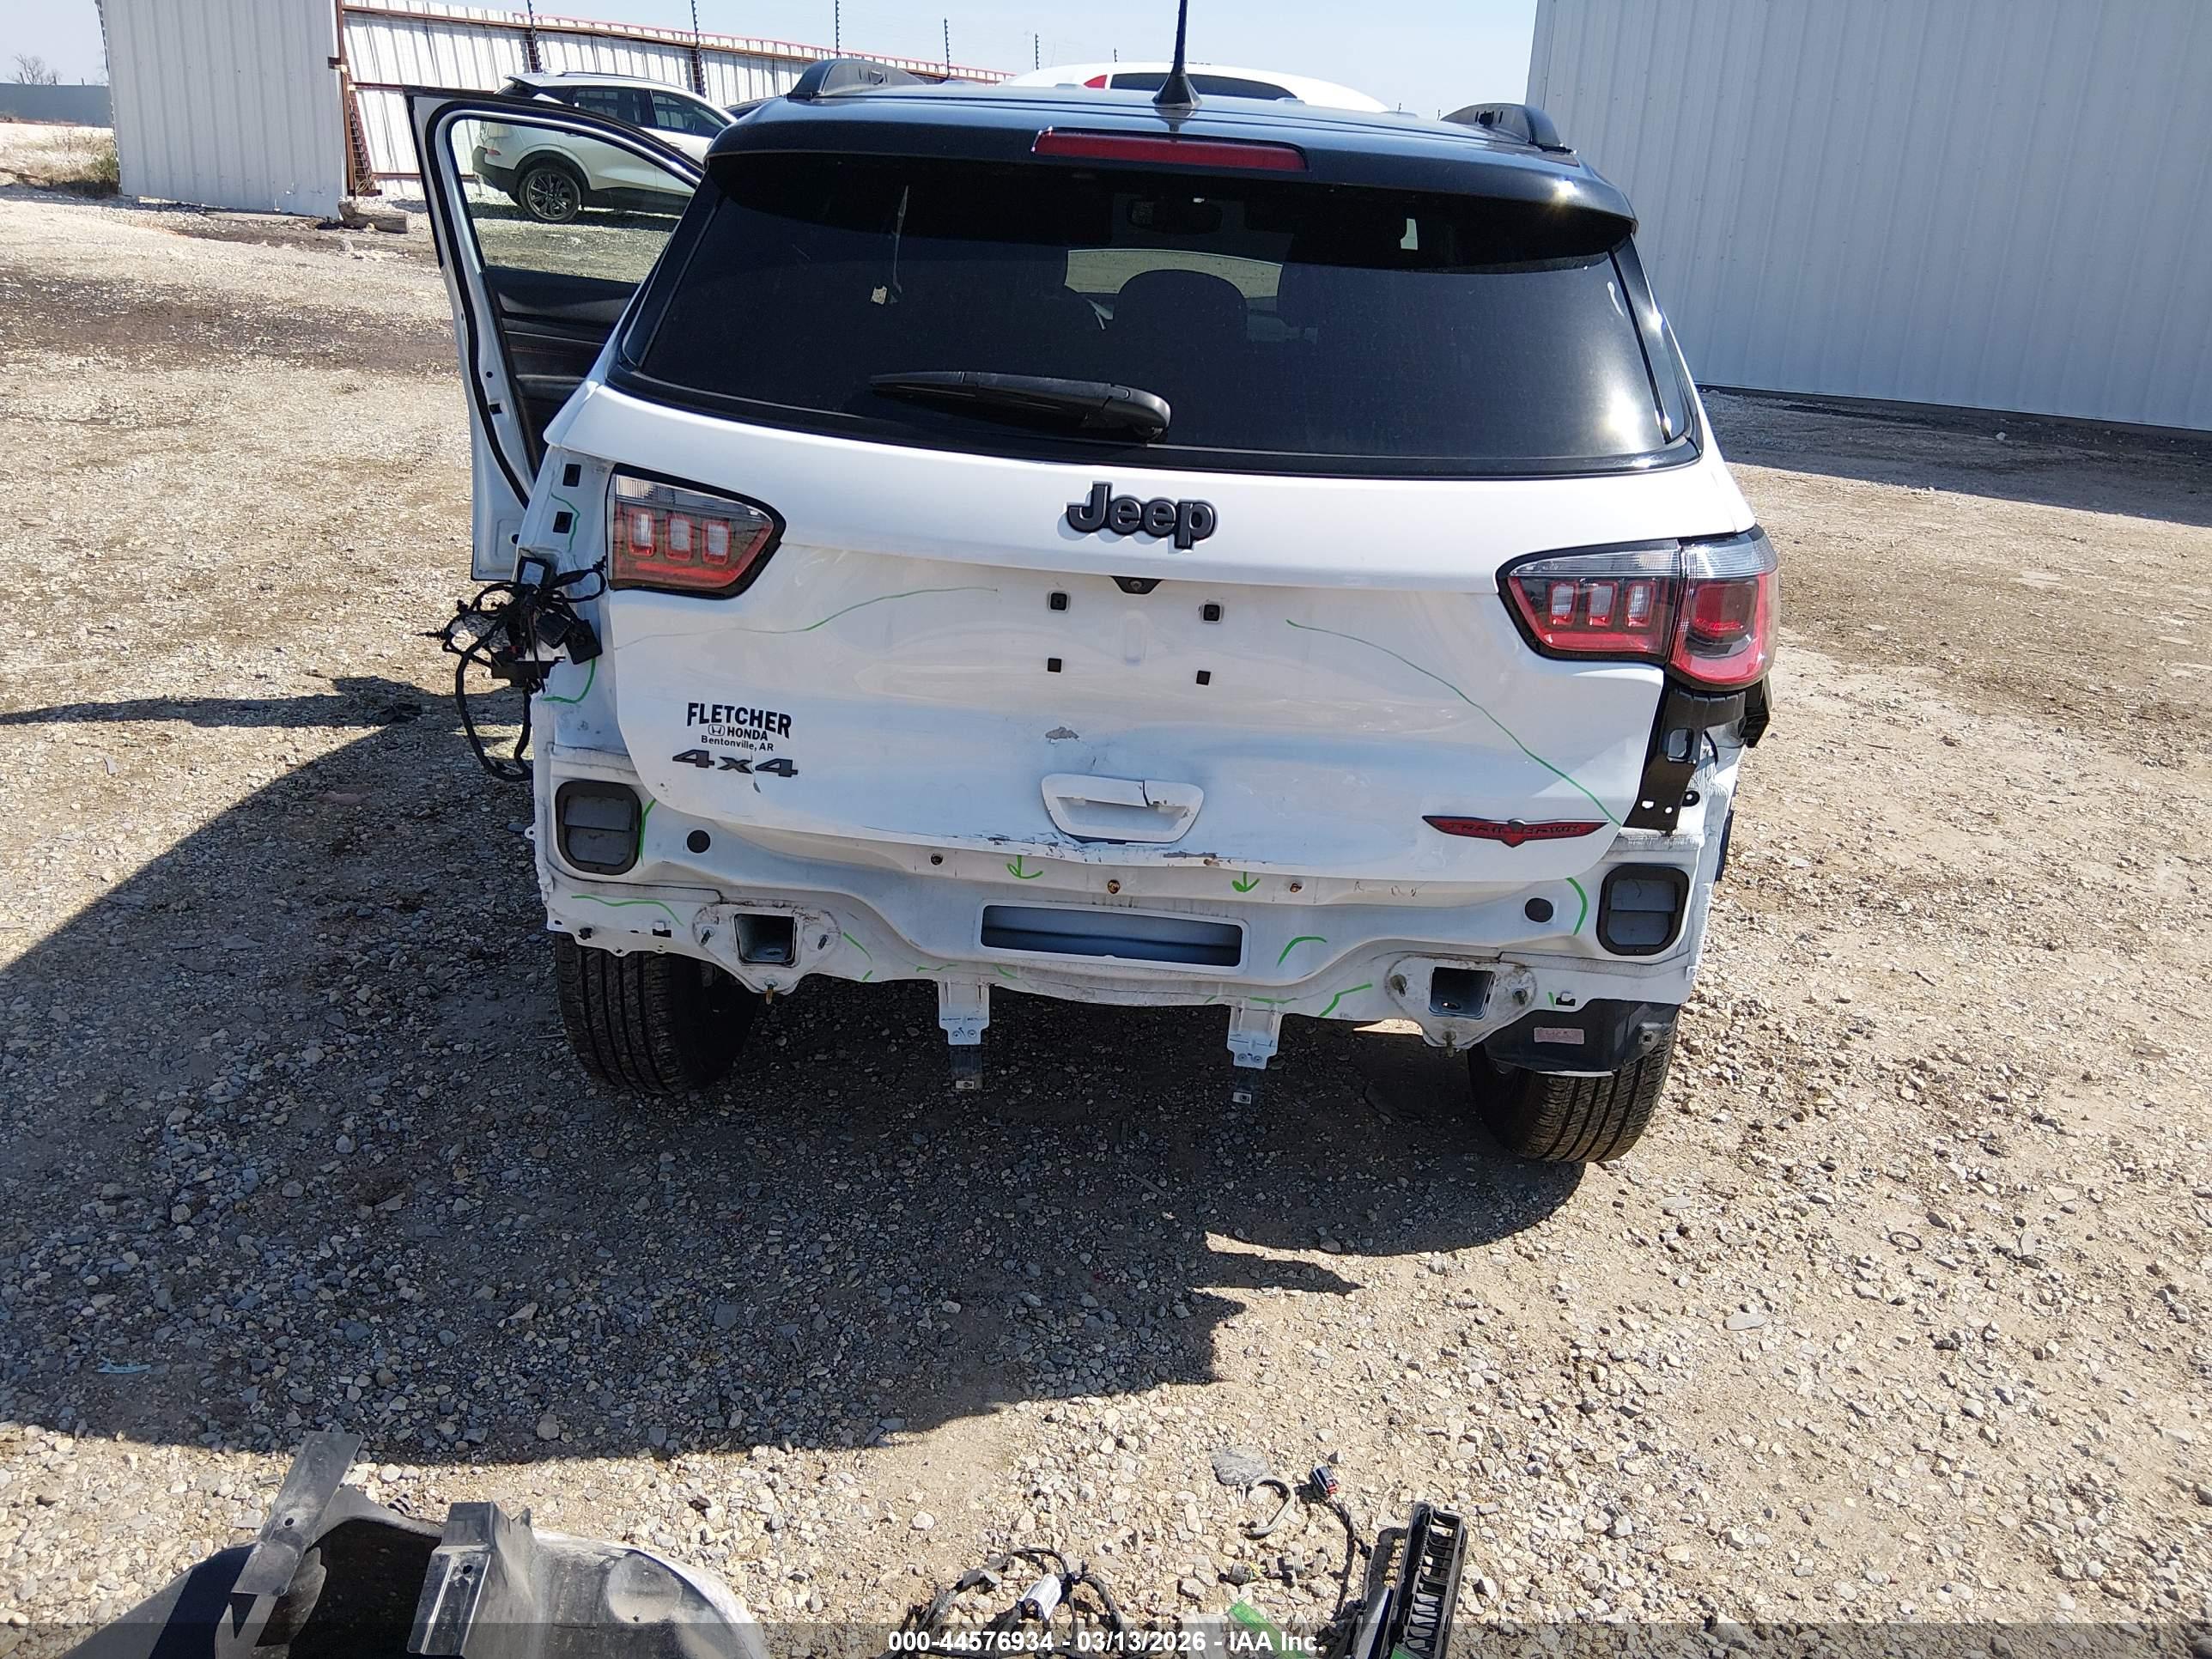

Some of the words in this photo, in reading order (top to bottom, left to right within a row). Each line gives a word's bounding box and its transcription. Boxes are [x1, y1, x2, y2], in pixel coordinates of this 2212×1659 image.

[1066, 481, 1218, 550] Jeep
[687, 702, 792, 739] FLETCHER
[726, 726, 769, 741] HONDA
[701, 735, 757, 751] Bentonville,
[759, 743, 775, 752] AR
